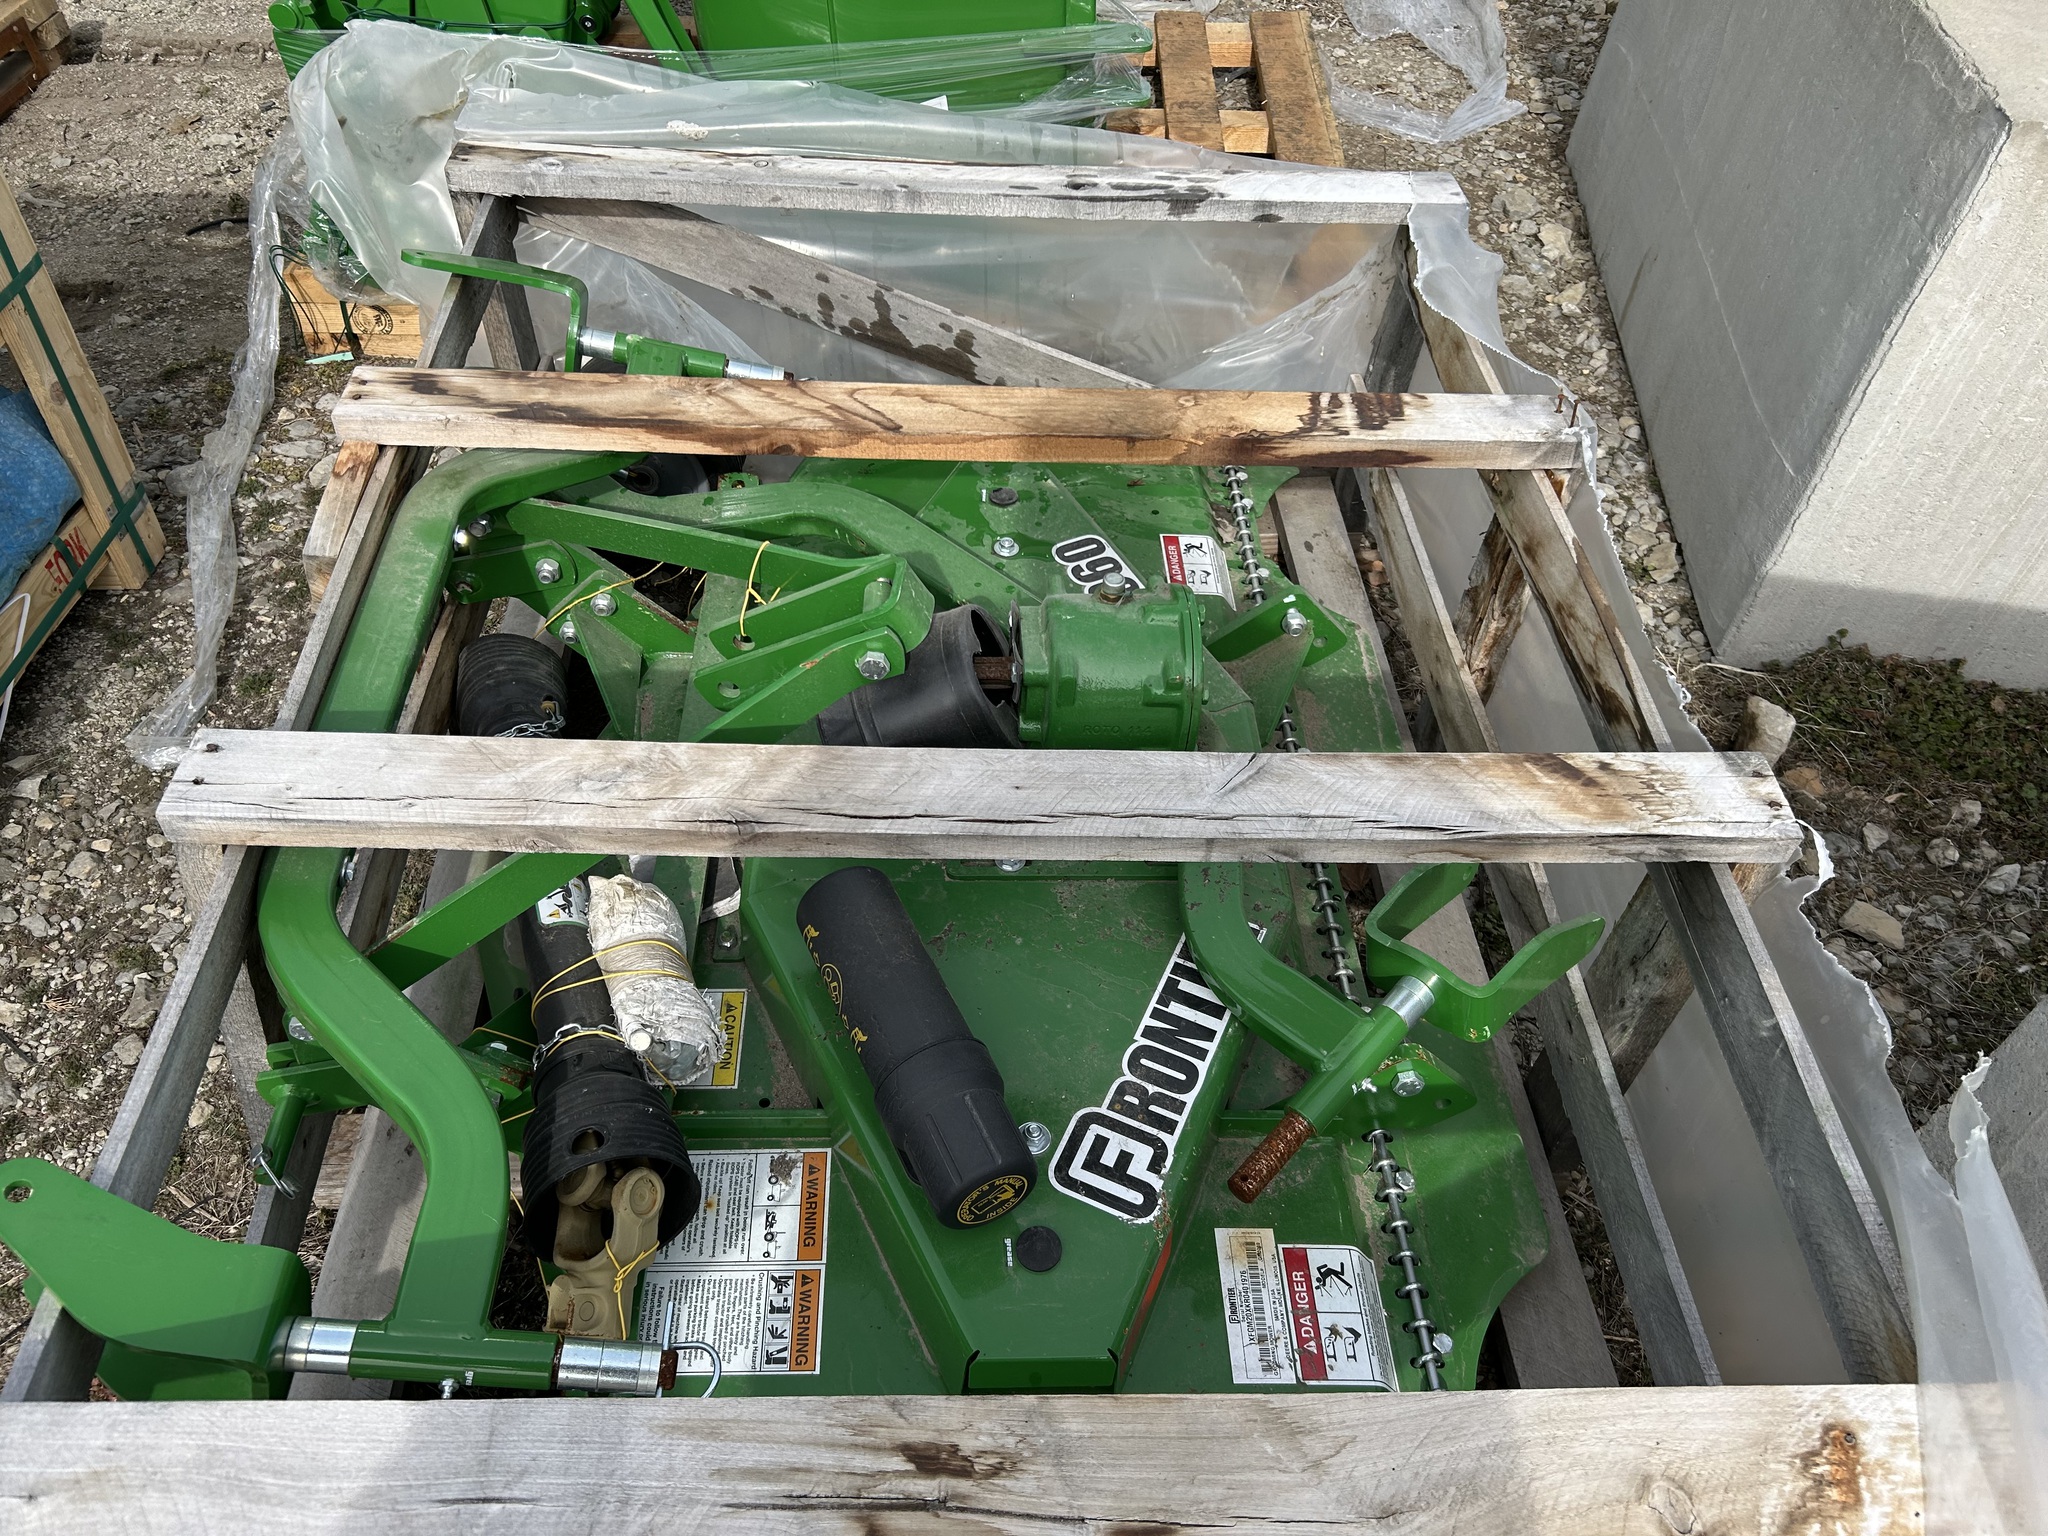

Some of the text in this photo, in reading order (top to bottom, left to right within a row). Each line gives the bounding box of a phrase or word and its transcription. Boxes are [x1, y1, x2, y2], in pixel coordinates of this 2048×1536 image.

[45, 524, 89, 594] FORK
[1168, 546, 1180, 574] DANGER
[719, 1014, 736, 1070] CAUTION
[1054, 923, 1264, 1218] FRONTI
[986, 1197, 1018, 1218] INSIDE
[994, 1178, 1023, 1190] MANUAL
[803, 1176, 819, 1247] WARNING
[1004, 1238, 1012, 1266] grease
[649, 1283, 657, 1321] instructions
[1228, 1288, 1239, 1323] FRONTIER
[1293, 1272, 1314, 1338] DANGER
[795, 1288, 812, 1366] WARNING
